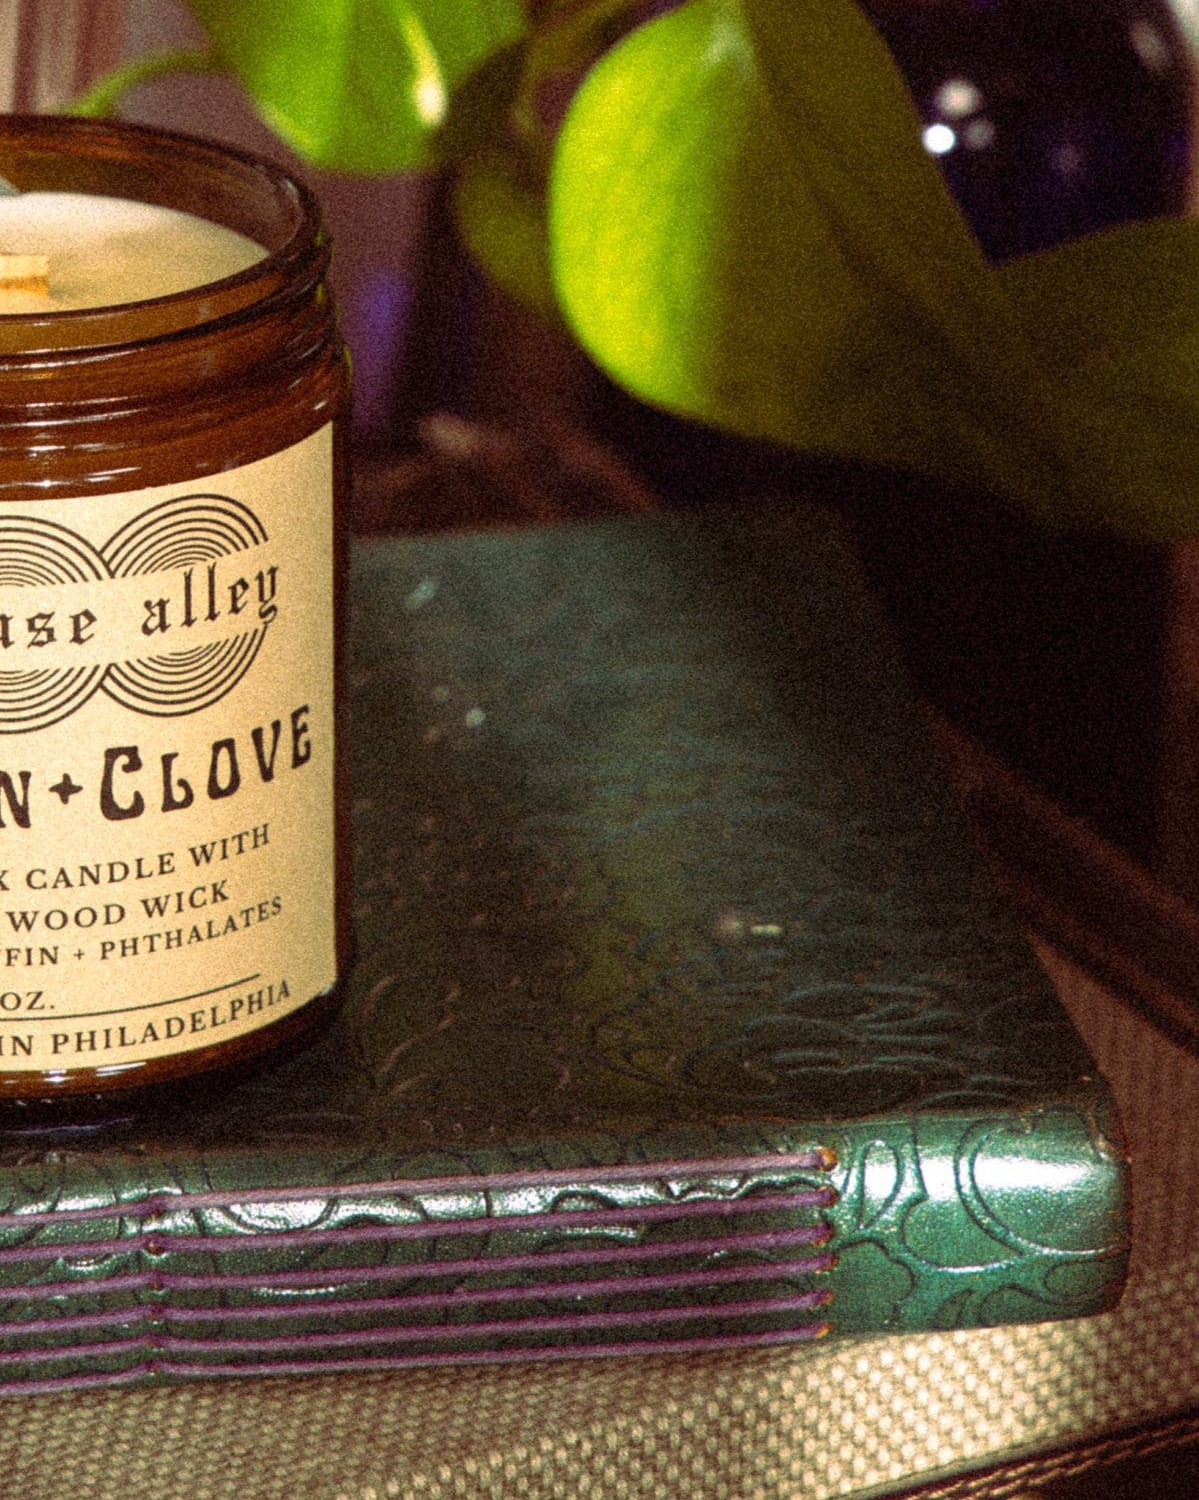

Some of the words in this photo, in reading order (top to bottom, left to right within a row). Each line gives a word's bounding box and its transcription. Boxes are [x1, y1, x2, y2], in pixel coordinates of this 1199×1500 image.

[140, 562, 279, 636] alley
[26, 852, 176, 890] CANDLE
[188, 823, 270, 867] WITH
[5, 903, 126, 933] WOOD
[141, 879, 229, 919] WICK
[100, 896, 283, 960] PHTHALATES
[0, 991, 56, 1011] OZ.
[51, 980, 291, 1055] PHILADELPHIA
